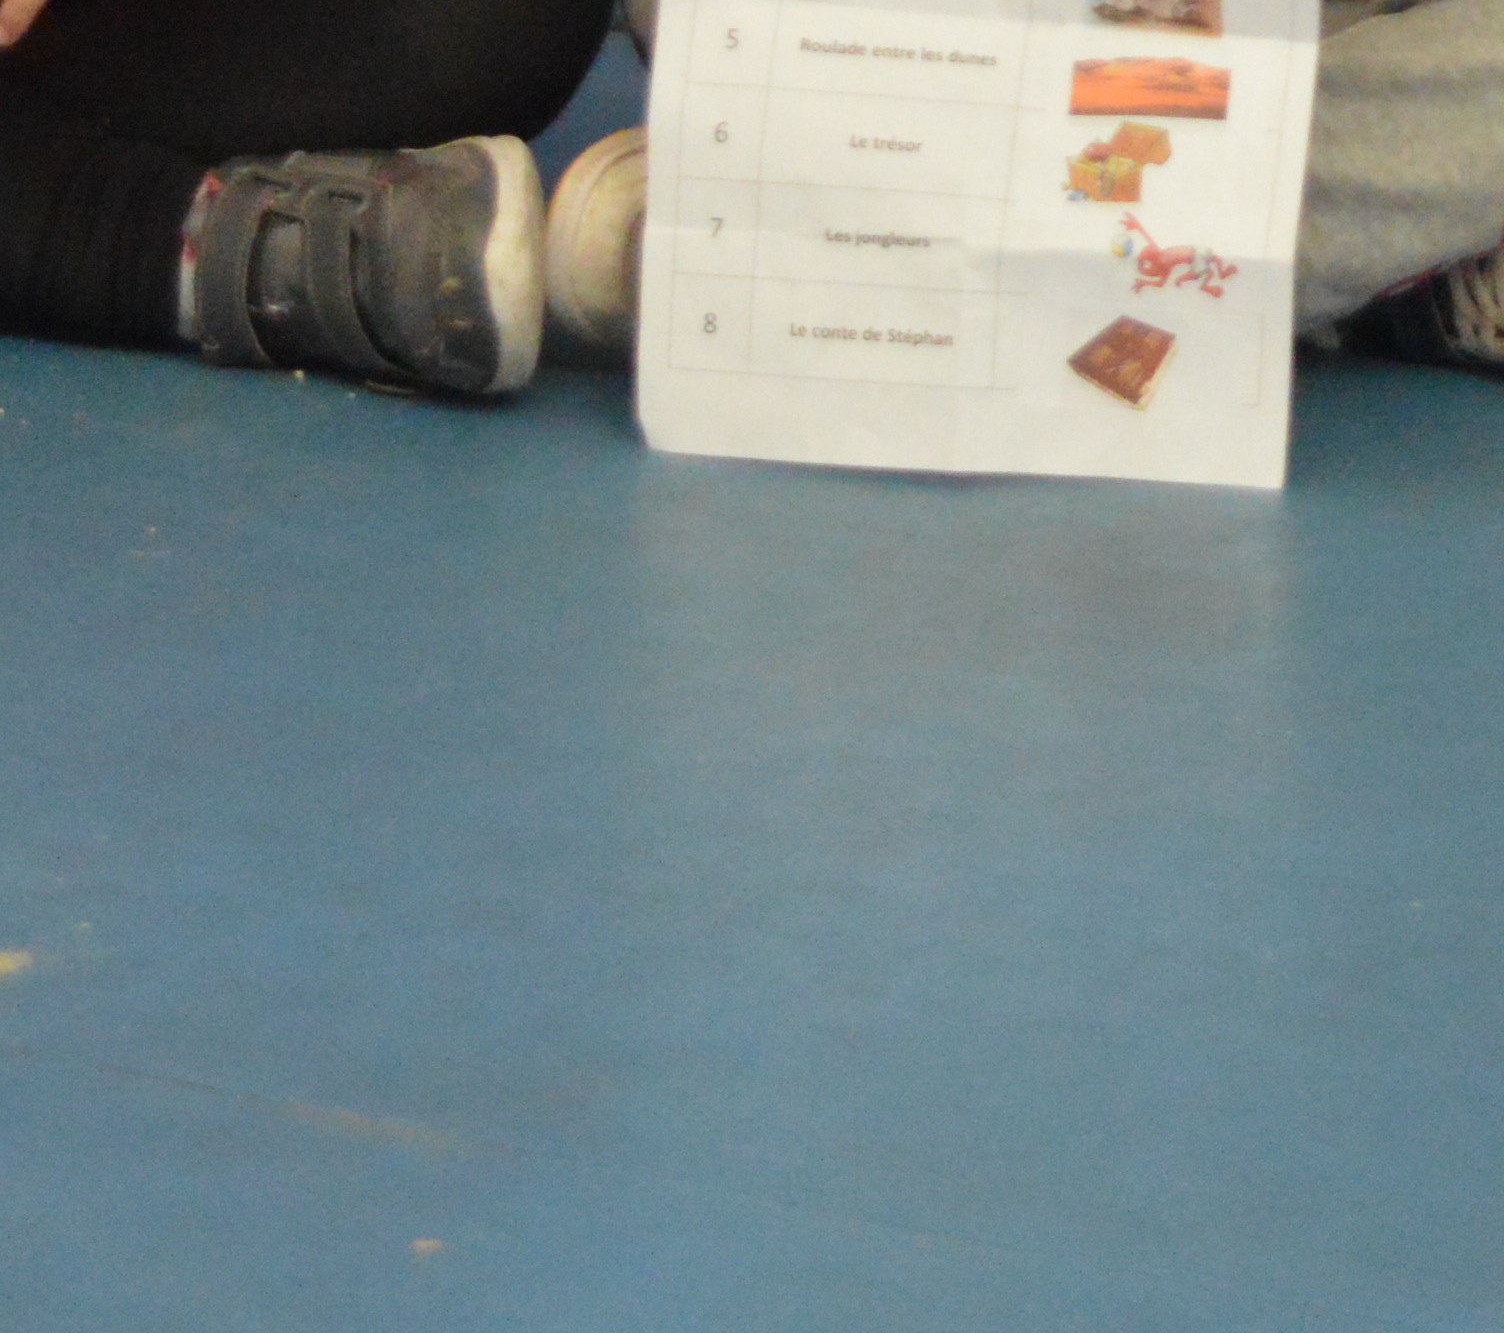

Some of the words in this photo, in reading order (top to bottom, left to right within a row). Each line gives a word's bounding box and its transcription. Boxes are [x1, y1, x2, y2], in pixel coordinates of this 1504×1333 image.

[725, 28, 740, 49] 5
[800, 37, 867, 56] Roulade
[872, 44, 916, 60] entre
[921, 47, 944, 63] les
[948, 49, 998, 66] dunes
[714, 121, 729, 144] 6
[850, 134, 868, 149] Le
[873, 136, 924, 153] trésor
[711, 217, 724, 238] 7
[825, 229, 852, 244] Les
[855, 230, 931, 249] jongleurs
[703, 312, 717, 334] 8
[790, 322, 808, 337] Le
[812, 325, 858, 341] conte
[863, 326, 883, 342] de
[887, 327, 954, 347] Stéphan
